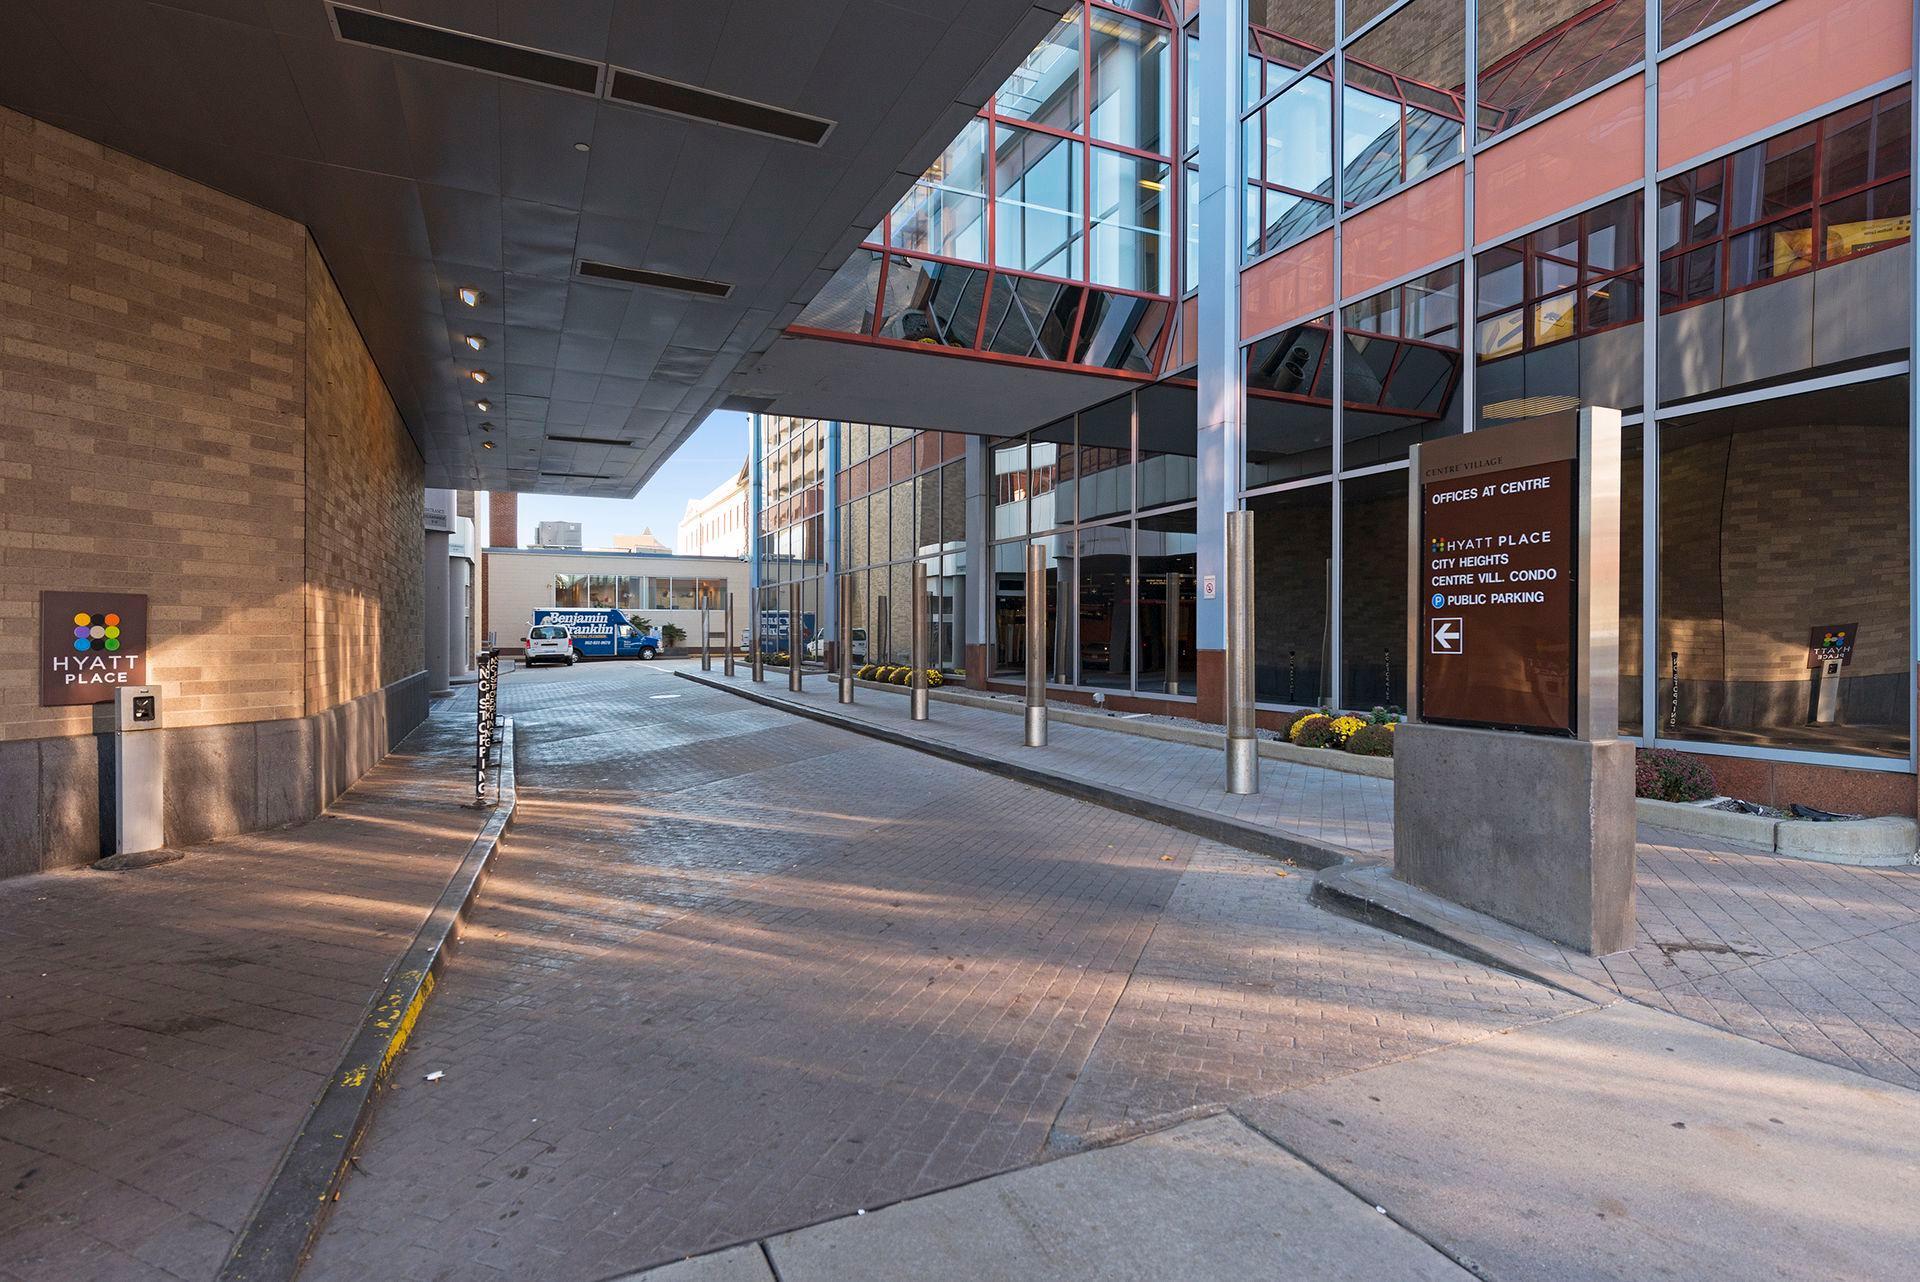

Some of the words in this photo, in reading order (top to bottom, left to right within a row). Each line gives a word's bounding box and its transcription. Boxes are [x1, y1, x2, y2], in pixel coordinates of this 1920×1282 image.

[1425, 464, 1461, 477] CENTRE
[1464, 456, 1503, 470] VILLAGE
[1432, 488, 1478, 505] OFFICES
[1482, 485, 1497, 497] AT
[1500, 476, 1551, 494] CENTRE
[1447, 537, 1493, 552] HYATT
[1498, 531, 1551, 547] PLACE
[1431, 558, 1455, 570] CITY
[1459, 553, 1509, 567] HEIGHTS
[1431, 574, 1474, 587] CENTRE
[1478, 572, 1505, 583] VILL.
[1509, 568, 1557, 582] CONDO
[1447, 594, 1487, 606] PUBLIC
[1491, 591, 1544, 604] PARKING
[549, 612, 608, 627] Benjamin
[566, 624, 614, 635] ranklin
[53, 655, 139, 671] HYATT
[65, 671, 128, 685] PLACE
